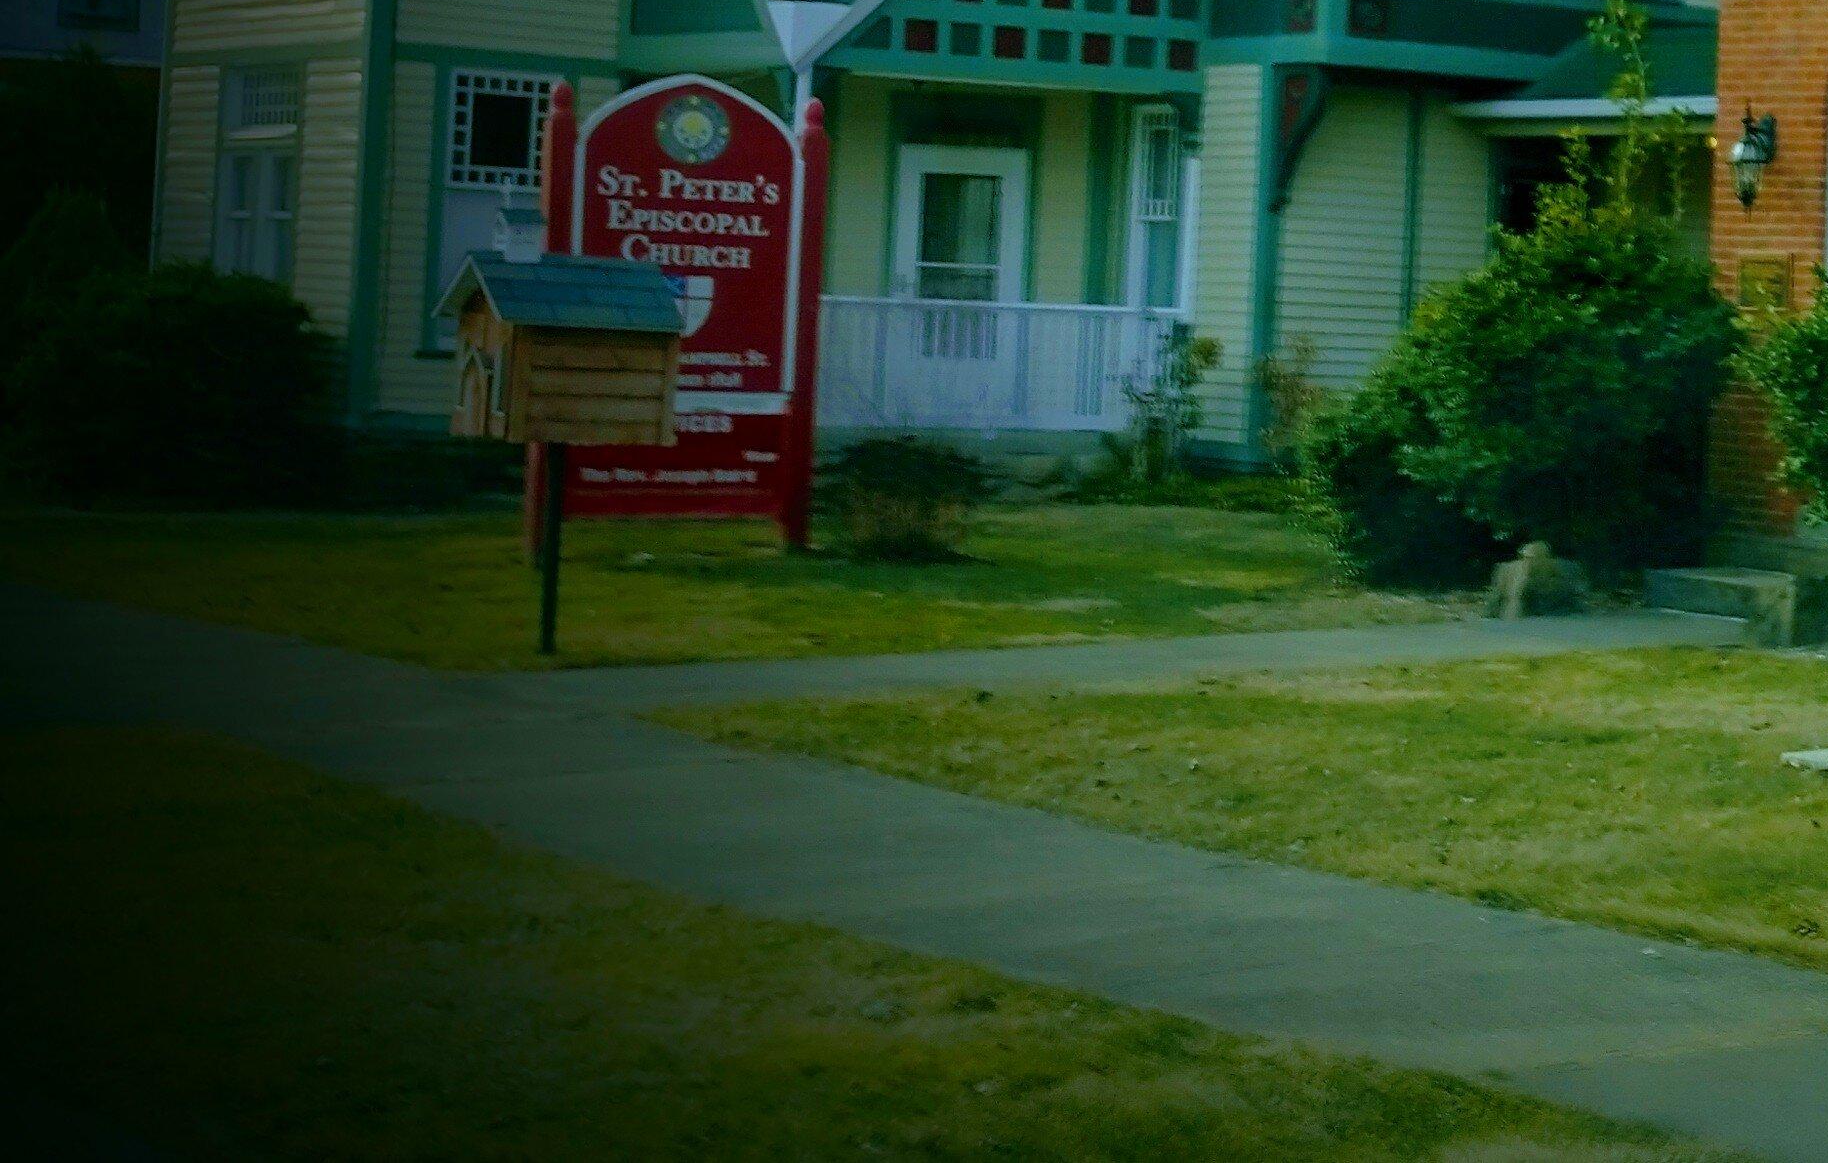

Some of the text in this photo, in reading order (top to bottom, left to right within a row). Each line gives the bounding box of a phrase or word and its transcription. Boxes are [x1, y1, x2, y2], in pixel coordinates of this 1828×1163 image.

[658, 168, 780, 205] PETER'S
[606, 198, 770, 237] EPISCOPAL
[620, 233, 751, 269] CHURCH
